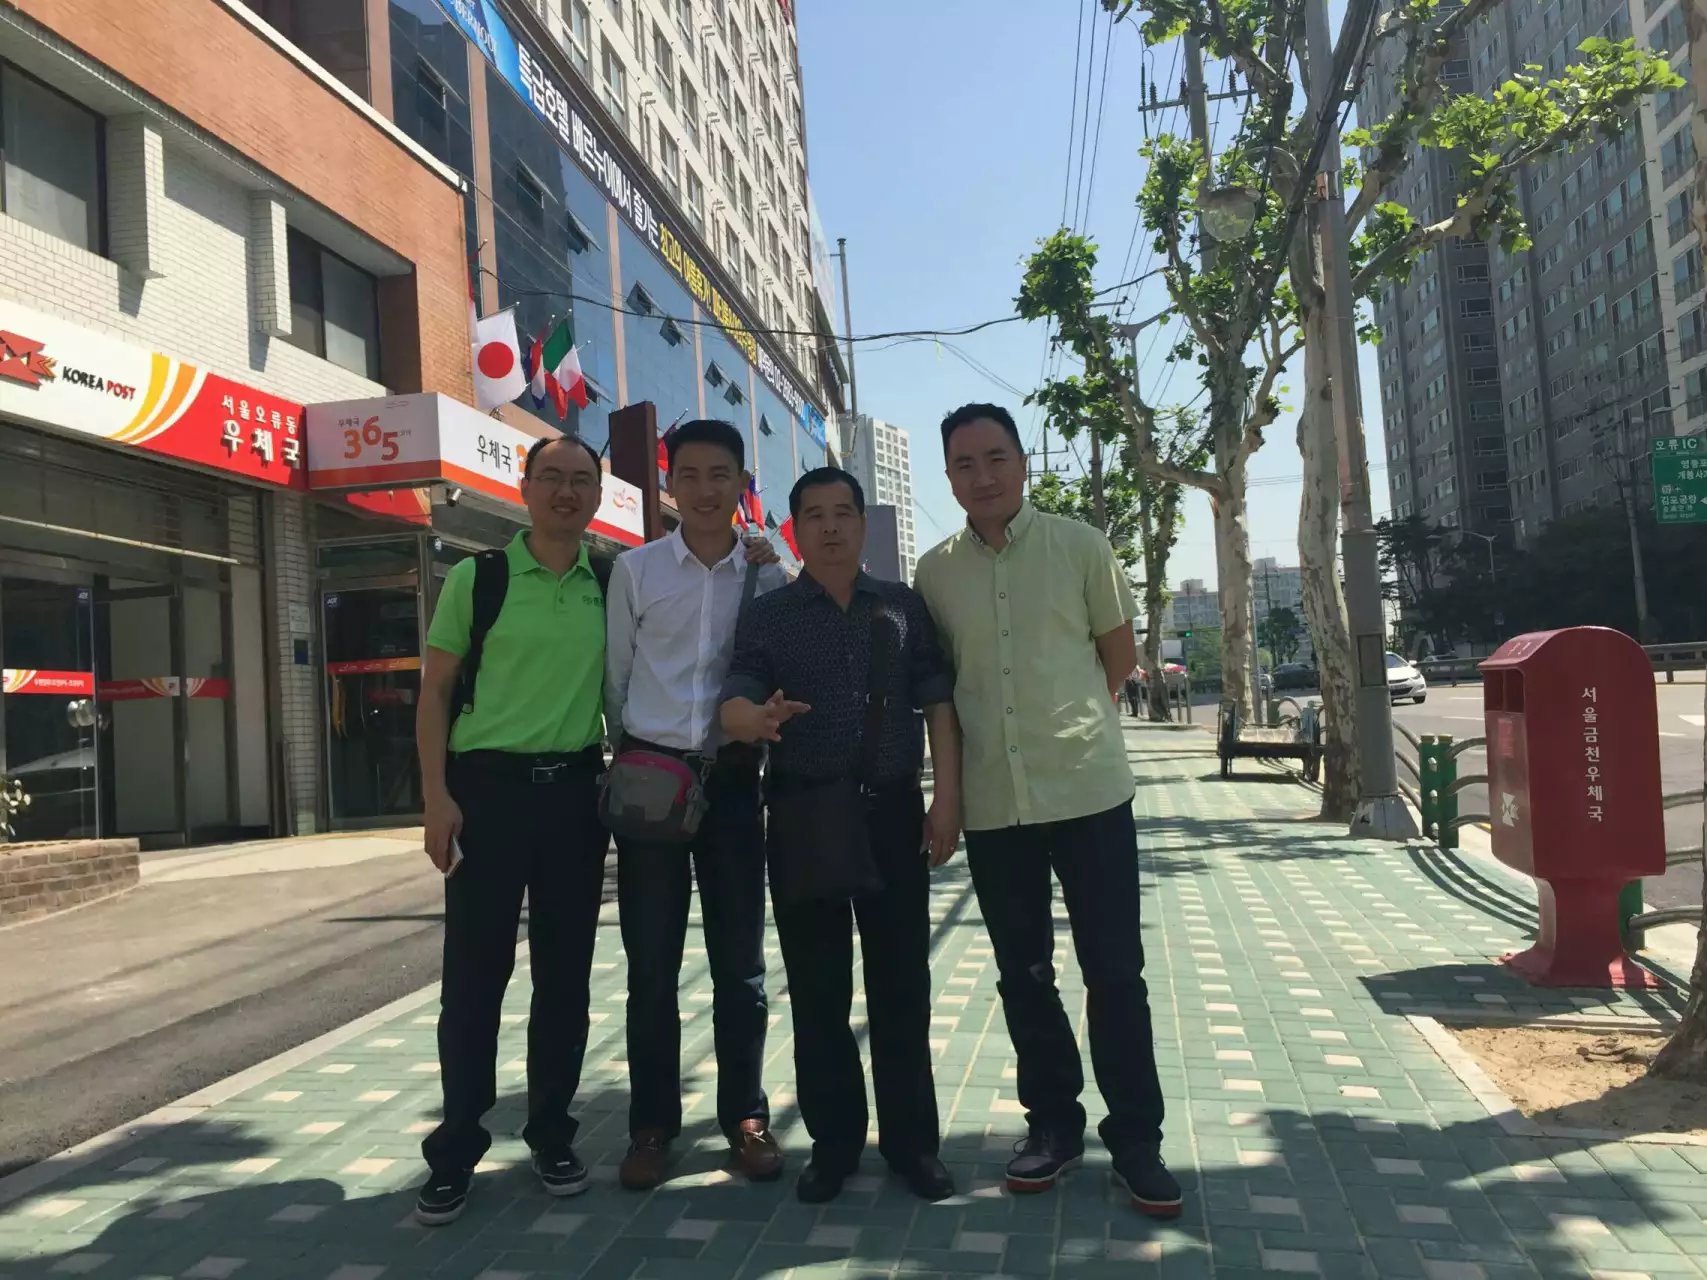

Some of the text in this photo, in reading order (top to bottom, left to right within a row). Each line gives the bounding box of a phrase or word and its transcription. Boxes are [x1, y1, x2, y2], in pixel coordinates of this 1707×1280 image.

[518, 42, 569, 144] 특급호텔
[571, 108, 632, 218] 베르누이에서
[633, 187, 658, 249] 즐기는
[62, 366, 136, 401] KOREA POST
[222, 395, 297, 435] 서울오류동
[222, 420, 299, 462] 우체국
[344, 416, 399, 461] 365
[477, 435, 511, 473] 우체국
[1660, 494, 1697, 505] 김포공항
[1581, 686, 1604, 823] 서울금천우체국
